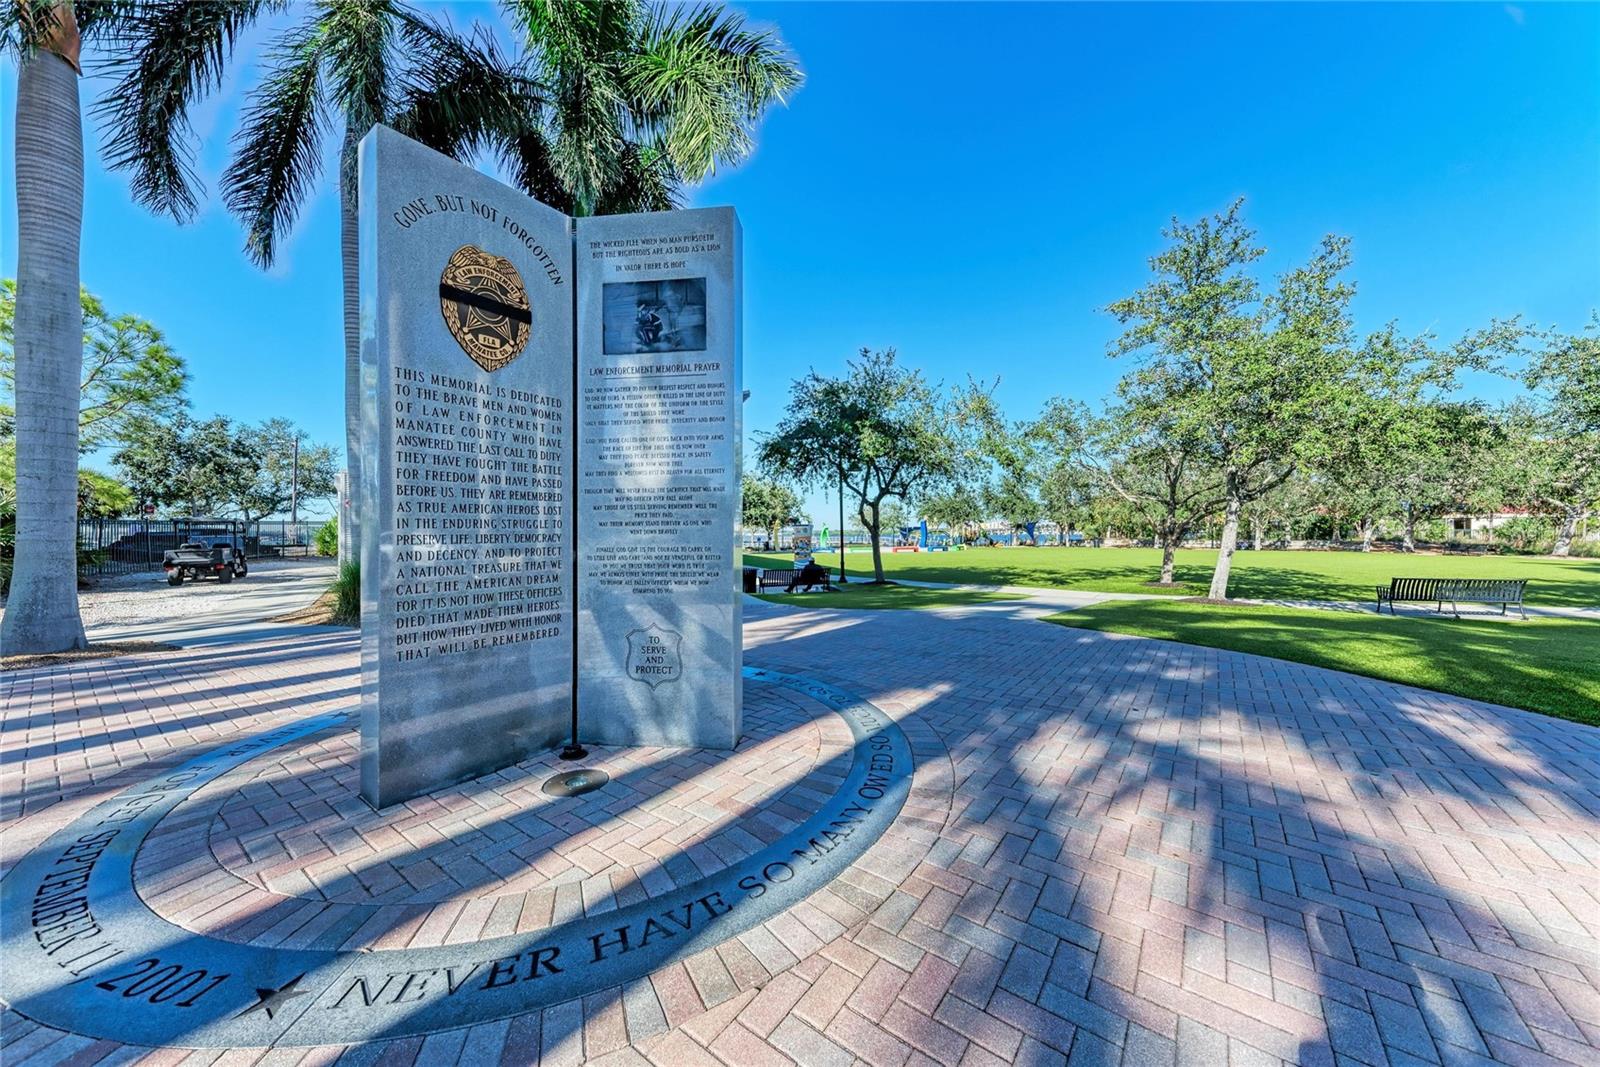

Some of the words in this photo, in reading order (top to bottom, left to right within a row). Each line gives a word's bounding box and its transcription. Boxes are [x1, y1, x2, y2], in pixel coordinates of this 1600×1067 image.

[435, 194, 465, 213] BUT
[470, 199, 499, 223] NOT
[502, 216, 565, 286] FORGOTTEN
[460, 268, 472, 276] LAW
[474, 268, 518, 295] ENFORCEMENT
[483, 337, 496, 345] FLA
[590, 368, 603, 376] LAW
[606, 366, 653, 376] ENFORCEMENT
[656, 364, 691, 374] MEMORIAL
[694, 363, 720, 372] PRAYER
[394, 366, 425, 383] THIS
[430, 373, 491, 395] MEMORIAL
[496, 385, 506, 397] IS
[510, 388, 561, 407] DEDICATED
[395, 383, 410, 397] TO
[415, 387, 438, 402] THE
[443, 391, 477, 408] BRAVE
[482, 398, 503, 412] MEN
[507, 402, 526, 415] AND
[530, 406, 561, 421] WOMEN
[395, 400, 413, 414] OF
[422, 404, 449, 419] LAW
[459, 410, 545, 432] ENFORCEMENT
[551, 424, 561, 434] IN
[395, 417, 455, 436] MANATEE
[461, 426, 506, 442] COUNTY
[512, 432, 534, 445] WHO
[539, 436, 561, 448] HAVE
[396, 434, 453, 451] ANSWERED
[457, 441, 475, 453] THE
[479, 443, 500, 456] LAST
[503, 446, 523, 458] CALL
[527, 448, 537, 459] TO
[540, 450, 560, 462] DUTY
[395, 451, 427, 465] THEY
[432, 454, 460, 467] HAVE
[465, 457, 506, 471] FOUGHT
[511, 461, 528, 473] THE
[532, 463, 561, 475] BATTLE
[396, 468, 419, 481] FOR
[425, 470, 475, 484] FREEDOM
[480, 474, 501, 485] AND
[505, 475, 528, 487] HAVE
[531, 477, 562, 489] PASSED
[396, 484, 437, 498] BEFORE
[460, 488, 485, 499] THEY
[488, 489, 506, 500] ARE
[509, 490, 562, 502] REMEMBERED
[396, 501, 411, 513] AS
[417, 502, 446, 514] TRUE
[451, 503, 502, 515] AMERICAN
[506, 505, 539, 515] HEROES
[543, 506, 562, 516] LOST
[396, 518, 408, 530] IN
[414, 518, 437, 529] THE
[442, 518, 496, 529] ENDURING
[501, 519, 548, 529] STRUGGLE
[552, 520, 562, 529] TO
[396, 534, 446, 546] PRESERVE
[514, 533, 561, 544] DEMOCRACY
[396, 551, 421, 563] AND
[484, 548, 504, 559] AND
[509, 548, 520, 558] TO
[524, 547, 561, 557] PROTECT
[396, 568, 404, 579] A
[410, 565, 466, 578] NATIONAL
[471, 562, 520, 575] TREASURE
[524, 561, 546, 572] THAT
[550, 560, 561, 570] WE
[396, 582, 429, 596] CALL
[435, 580, 459, 593] THE
[465, 576, 521, 590] AMERICAN
[526, 574, 558, 586] DREAM
[396, 599, 417, 613] FOR
[422, 598, 432, 610] IT
[437, 597, 446, 608] IS
[450, 595, 469, 607] NOT
[472, 593, 493, 605] HOW
[497, 590, 523, 602] THESE
[526, 587, 562, 600] OFFICERS
[396, 615, 425, 629] DIED
[430, 611, 459, 625] THAT
[464, 607, 493, 621] MADE
[497, 604, 522, 617] THEM
[527, 600, 559, 613] HEROES
[396, 631, 418, 646] BUT
[422, 628, 446, 642] HOW
[451, 624, 476, 638] THEY
[480, 620, 506, 634] LIVED
[509, 617, 531, 630] WITH
[534, 614, 561, 626] HONOR
[649, 636, 660, 644] TO
[396, 646, 430, 662] THAT
[438, 640, 467, 655] WILL
[473, 638, 486, 650] BE
[492, 627, 559, 647] REMEMBERED
[641, 646, 666, 654] SERVE
[635, 666, 673, 674] PROTECT
[645, 656, 664, 664] AND
[869, 735, 892, 751] SO
[858, 752, 894, 800] OWED
[791, 801, 873, 866] MANY
[738, 861, 796, 900] SO
[32, 829, 121, 956] SEPTEMBER
[95, 958, 232, 1008] 2001
[587, 891, 733, 965] HAVE
[327, 946, 564, 1010] NEVER
